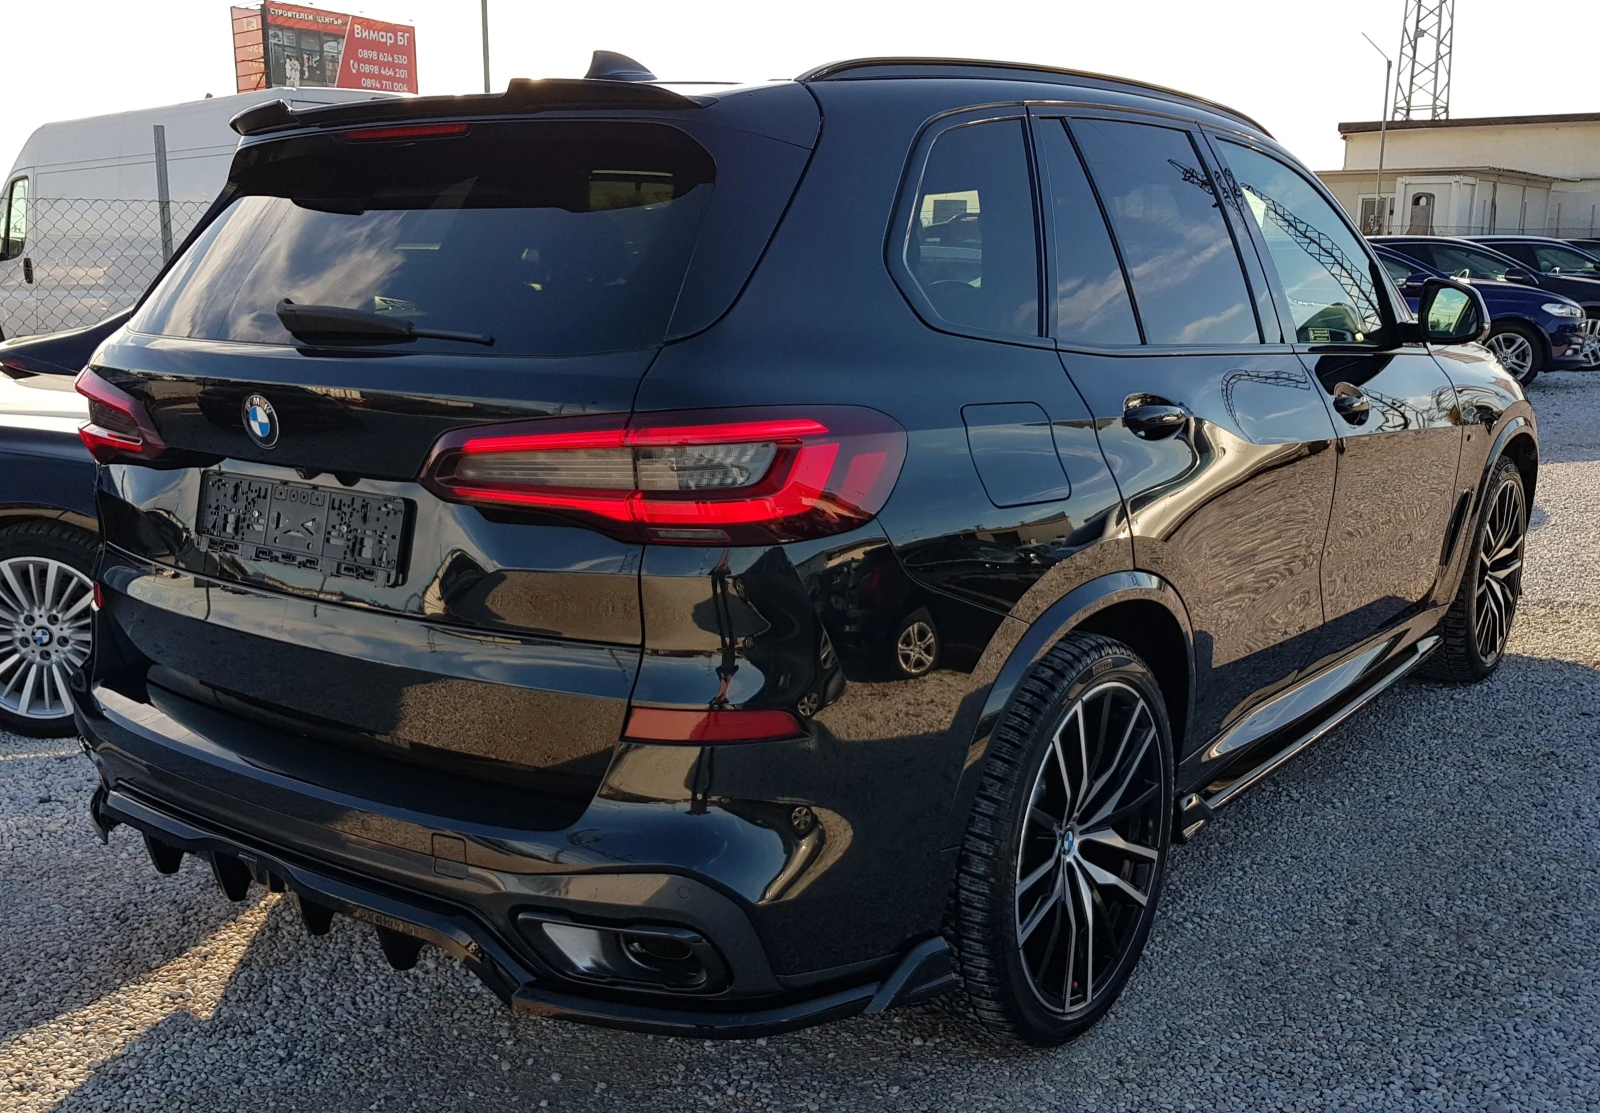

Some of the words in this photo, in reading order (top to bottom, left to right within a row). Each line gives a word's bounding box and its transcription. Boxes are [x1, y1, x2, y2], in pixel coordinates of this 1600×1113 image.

[269, 8, 313, 20] СТРОИТЕЛЕН
[316, 15, 342, 25] ЦЕНТЪР
[354, 24, 395, 46] Вимар
[397, 31, 410, 46] БГ
[358, 48, 378, 60] 0898
[379, 52, 393, 62] 624
[394, 54, 408, 65] 530
[359, 63, 379, 74] 0898
[380, 66, 394, 76] 464
[395, 68, 408, 78] 201
[361, 77, 380, 89] 0894
[381, 80, 392, 90] 711
[393, 82, 408, 92] 004
